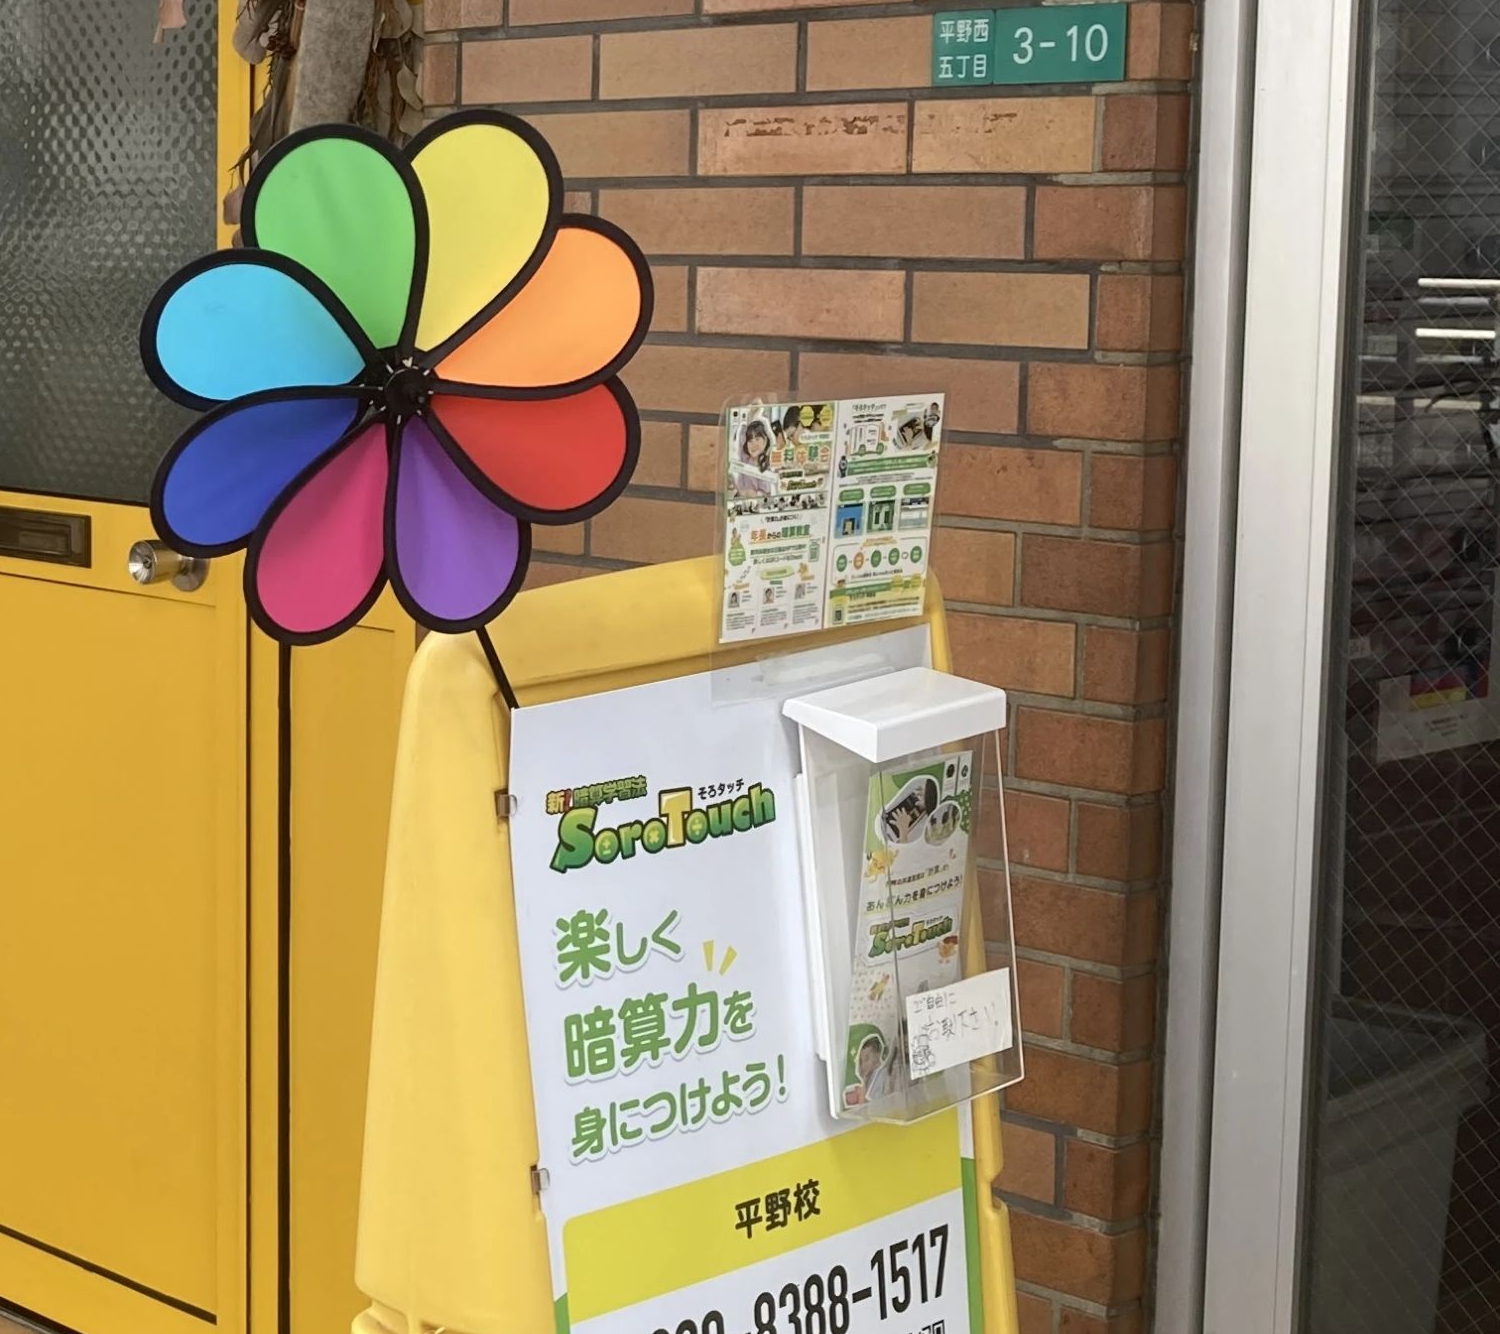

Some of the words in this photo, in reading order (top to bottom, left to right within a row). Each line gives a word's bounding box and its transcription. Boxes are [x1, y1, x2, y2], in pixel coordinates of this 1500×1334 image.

[940, 18, 989, 44] 平野西
[1013, 23, 1108, 65] 3-10
[938, 54, 987, 79] 五丁目
[698, 778, 744, 800] そろタッチ
[550, 782, 776, 874] SoroTouch
[556, 908, 683, 983] 楽しく
[564, 982, 754, 1079] 暗算力を
[571, 1053, 787, 1158] 身につけよう!
[734, 1179, 821, 1239] 平野校
